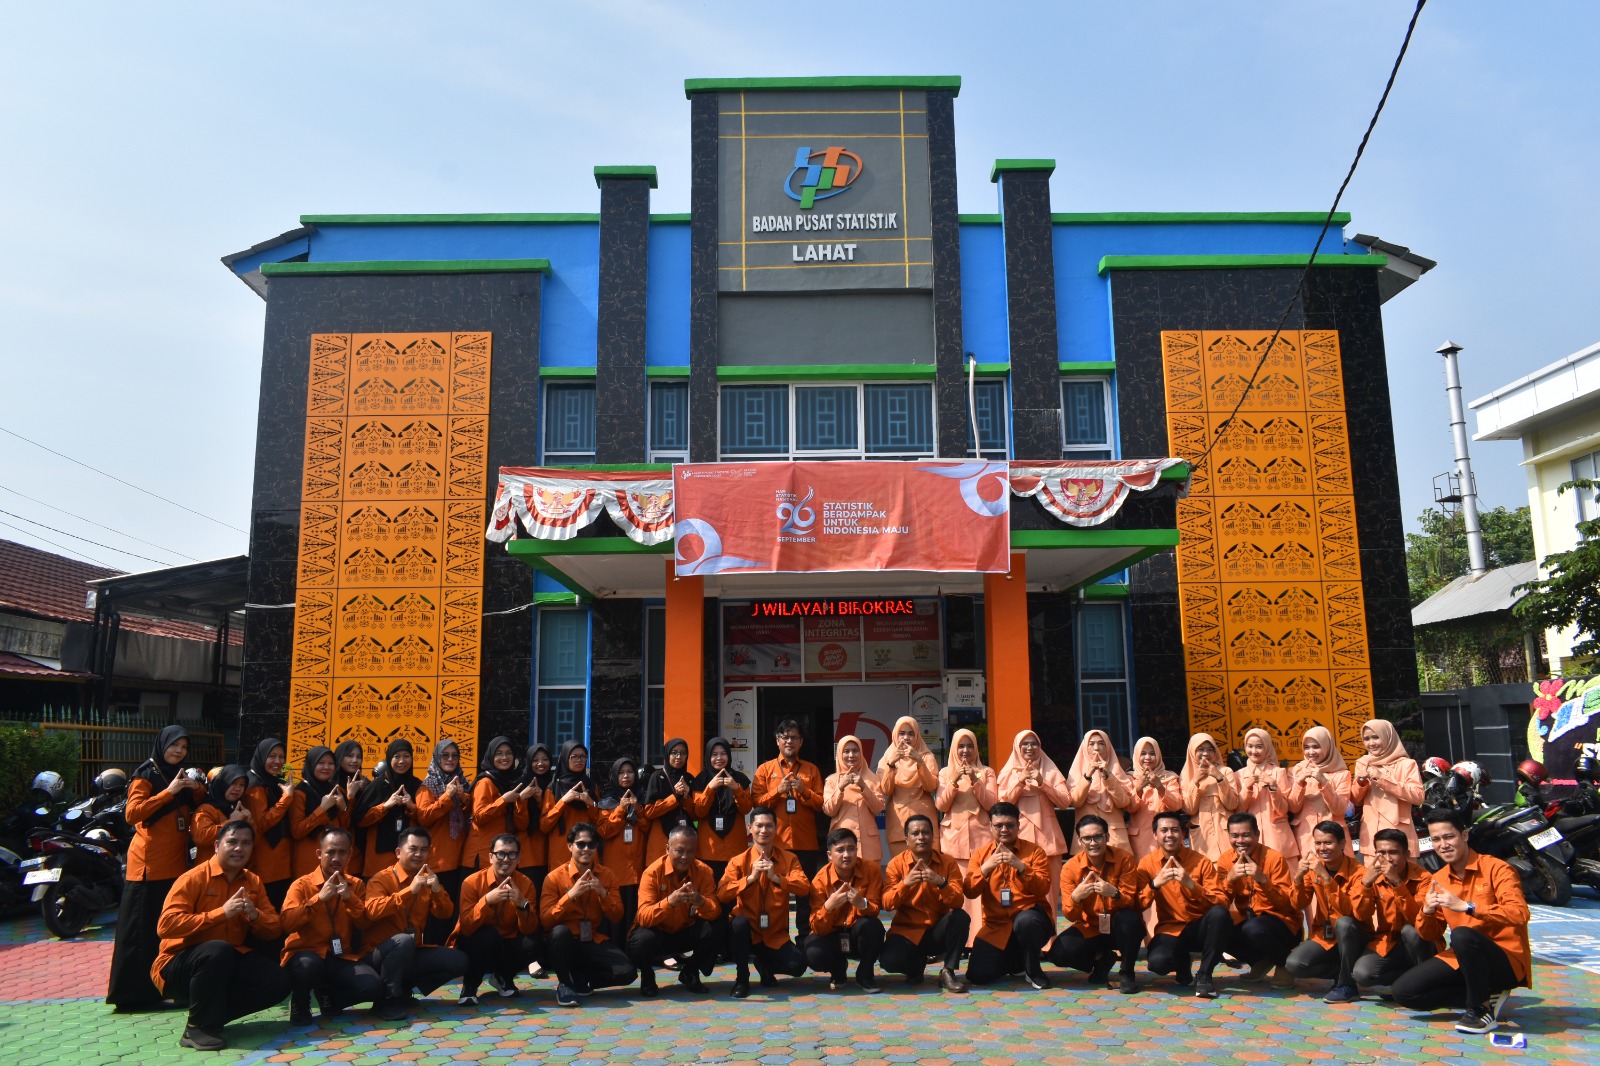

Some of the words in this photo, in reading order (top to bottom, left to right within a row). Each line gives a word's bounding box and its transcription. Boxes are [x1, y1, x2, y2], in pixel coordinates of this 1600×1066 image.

[752, 215, 793, 232] BADAN
[795, 214, 834, 231] PUSAT
[836, 212, 898, 229] STATISTIK
[792, 243, 857, 262] LAHAT
[823, 502, 874, 510] STATISTIK
[823, 510, 887, 518] BERDAMPAK
[823, 518, 858, 526] UNTUK
[823, 526, 880, 535] INDONESIA
[882, 526, 910, 534] MAJU
[762, 602, 834, 616] WILAYAH
[817, 619, 846, 628] ZONA
[805, 628, 860, 637] INTEGRITAS
